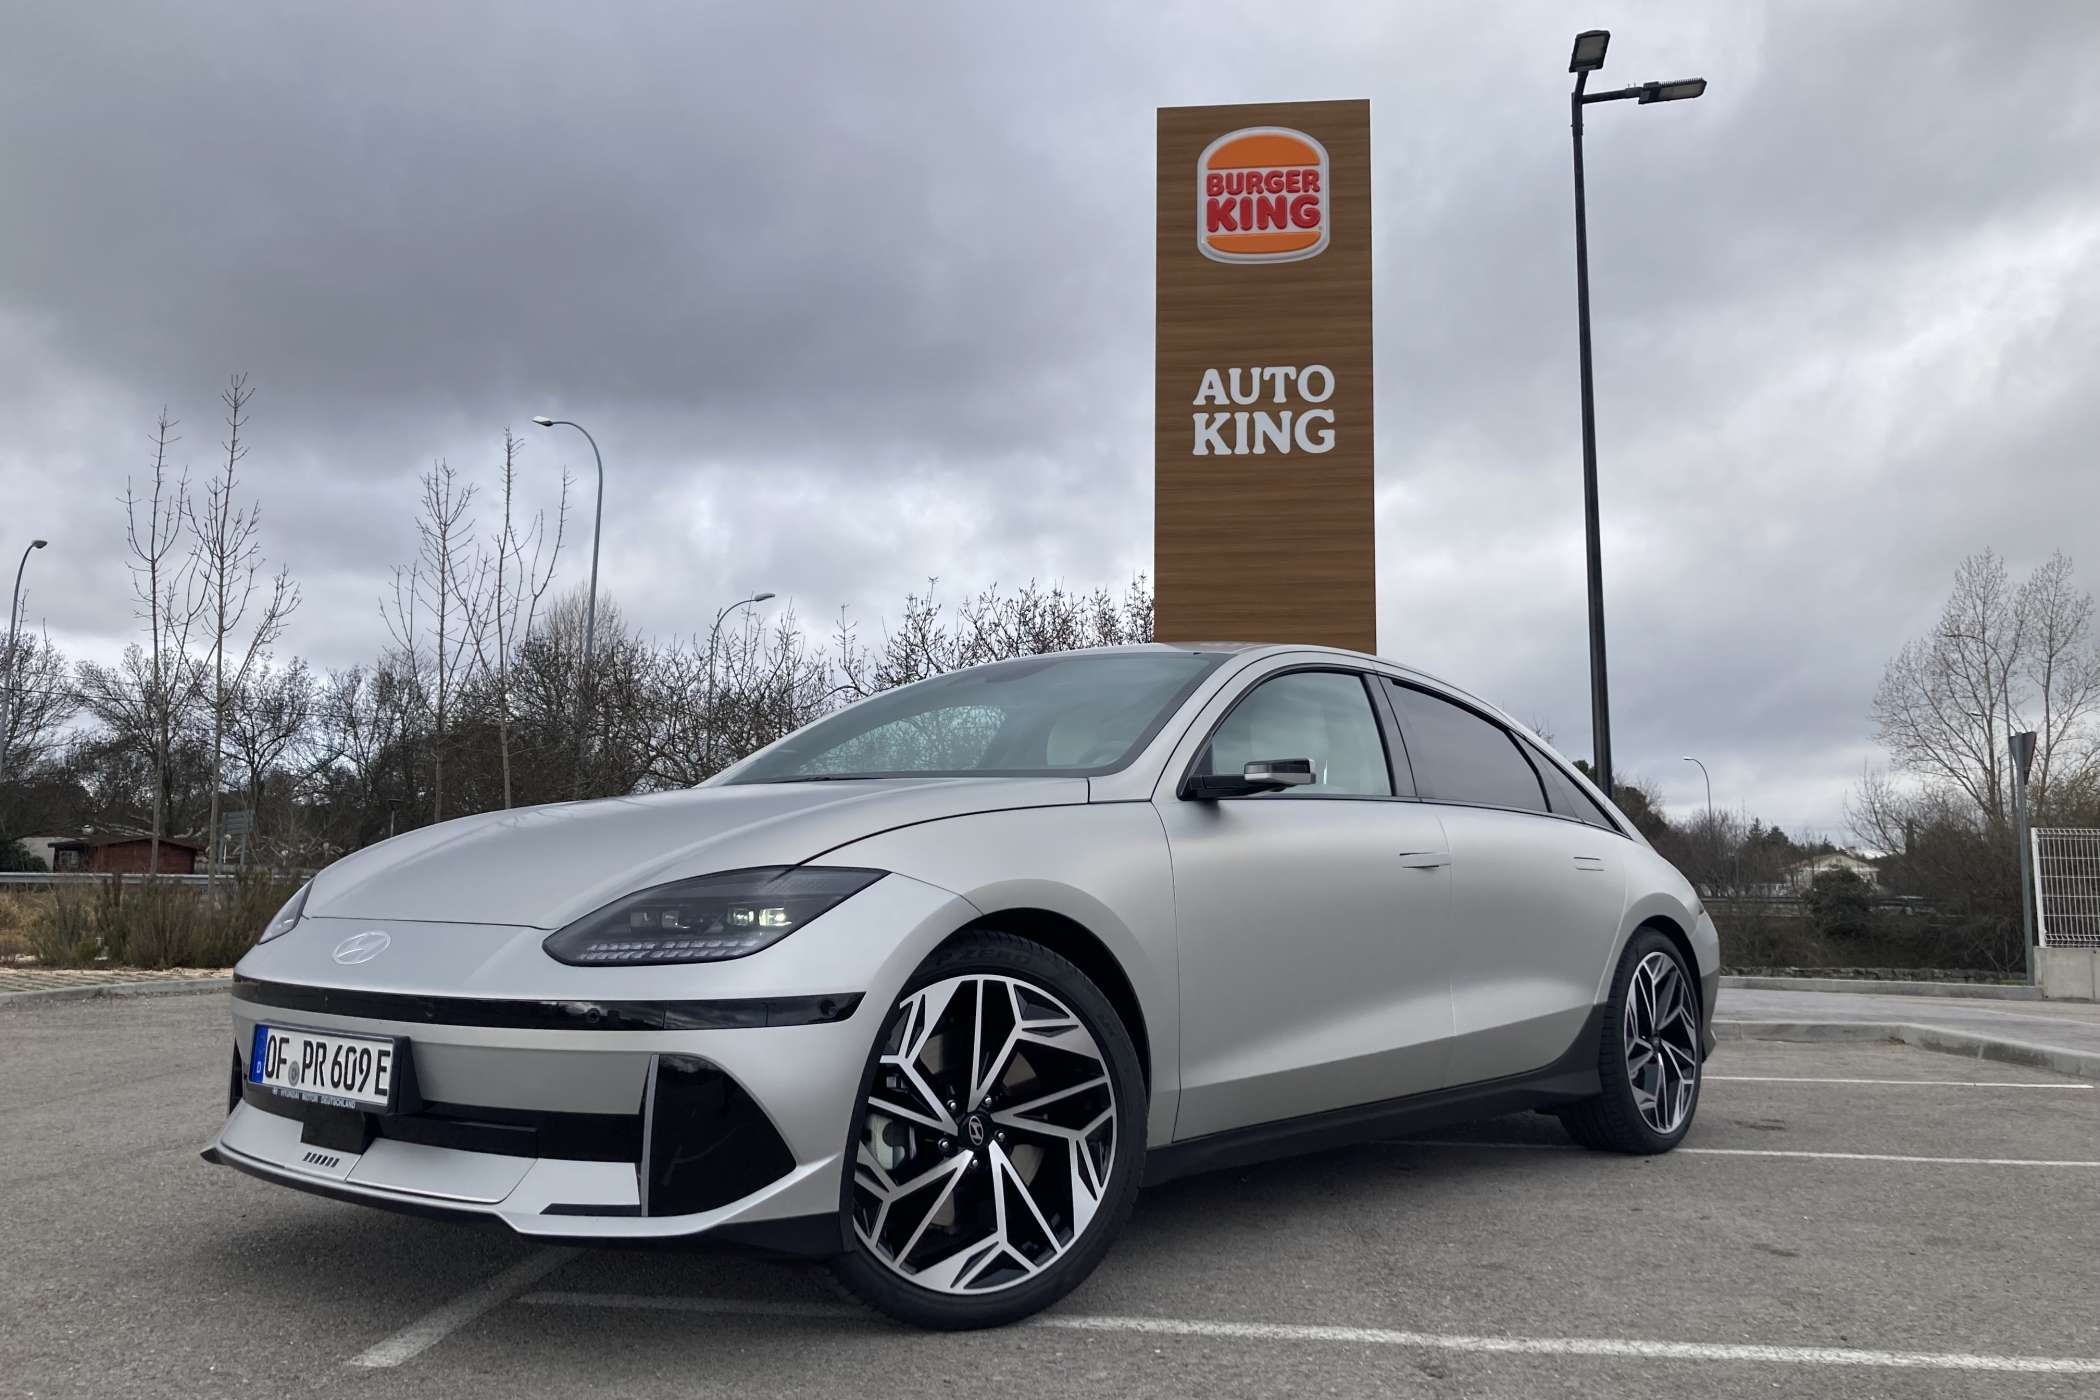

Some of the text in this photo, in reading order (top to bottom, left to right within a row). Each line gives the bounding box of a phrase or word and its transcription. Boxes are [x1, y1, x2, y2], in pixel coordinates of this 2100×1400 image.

[1206, 169, 1321, 197] BURGER
[1206, 194, 1321, 233] KING
[1192, 364, 1336, 406] AUTO
[1192, 408, 1336, 456] KING
[265, 1034, 290, 1080] OF
[301, 1039, 328, 1087] PR
